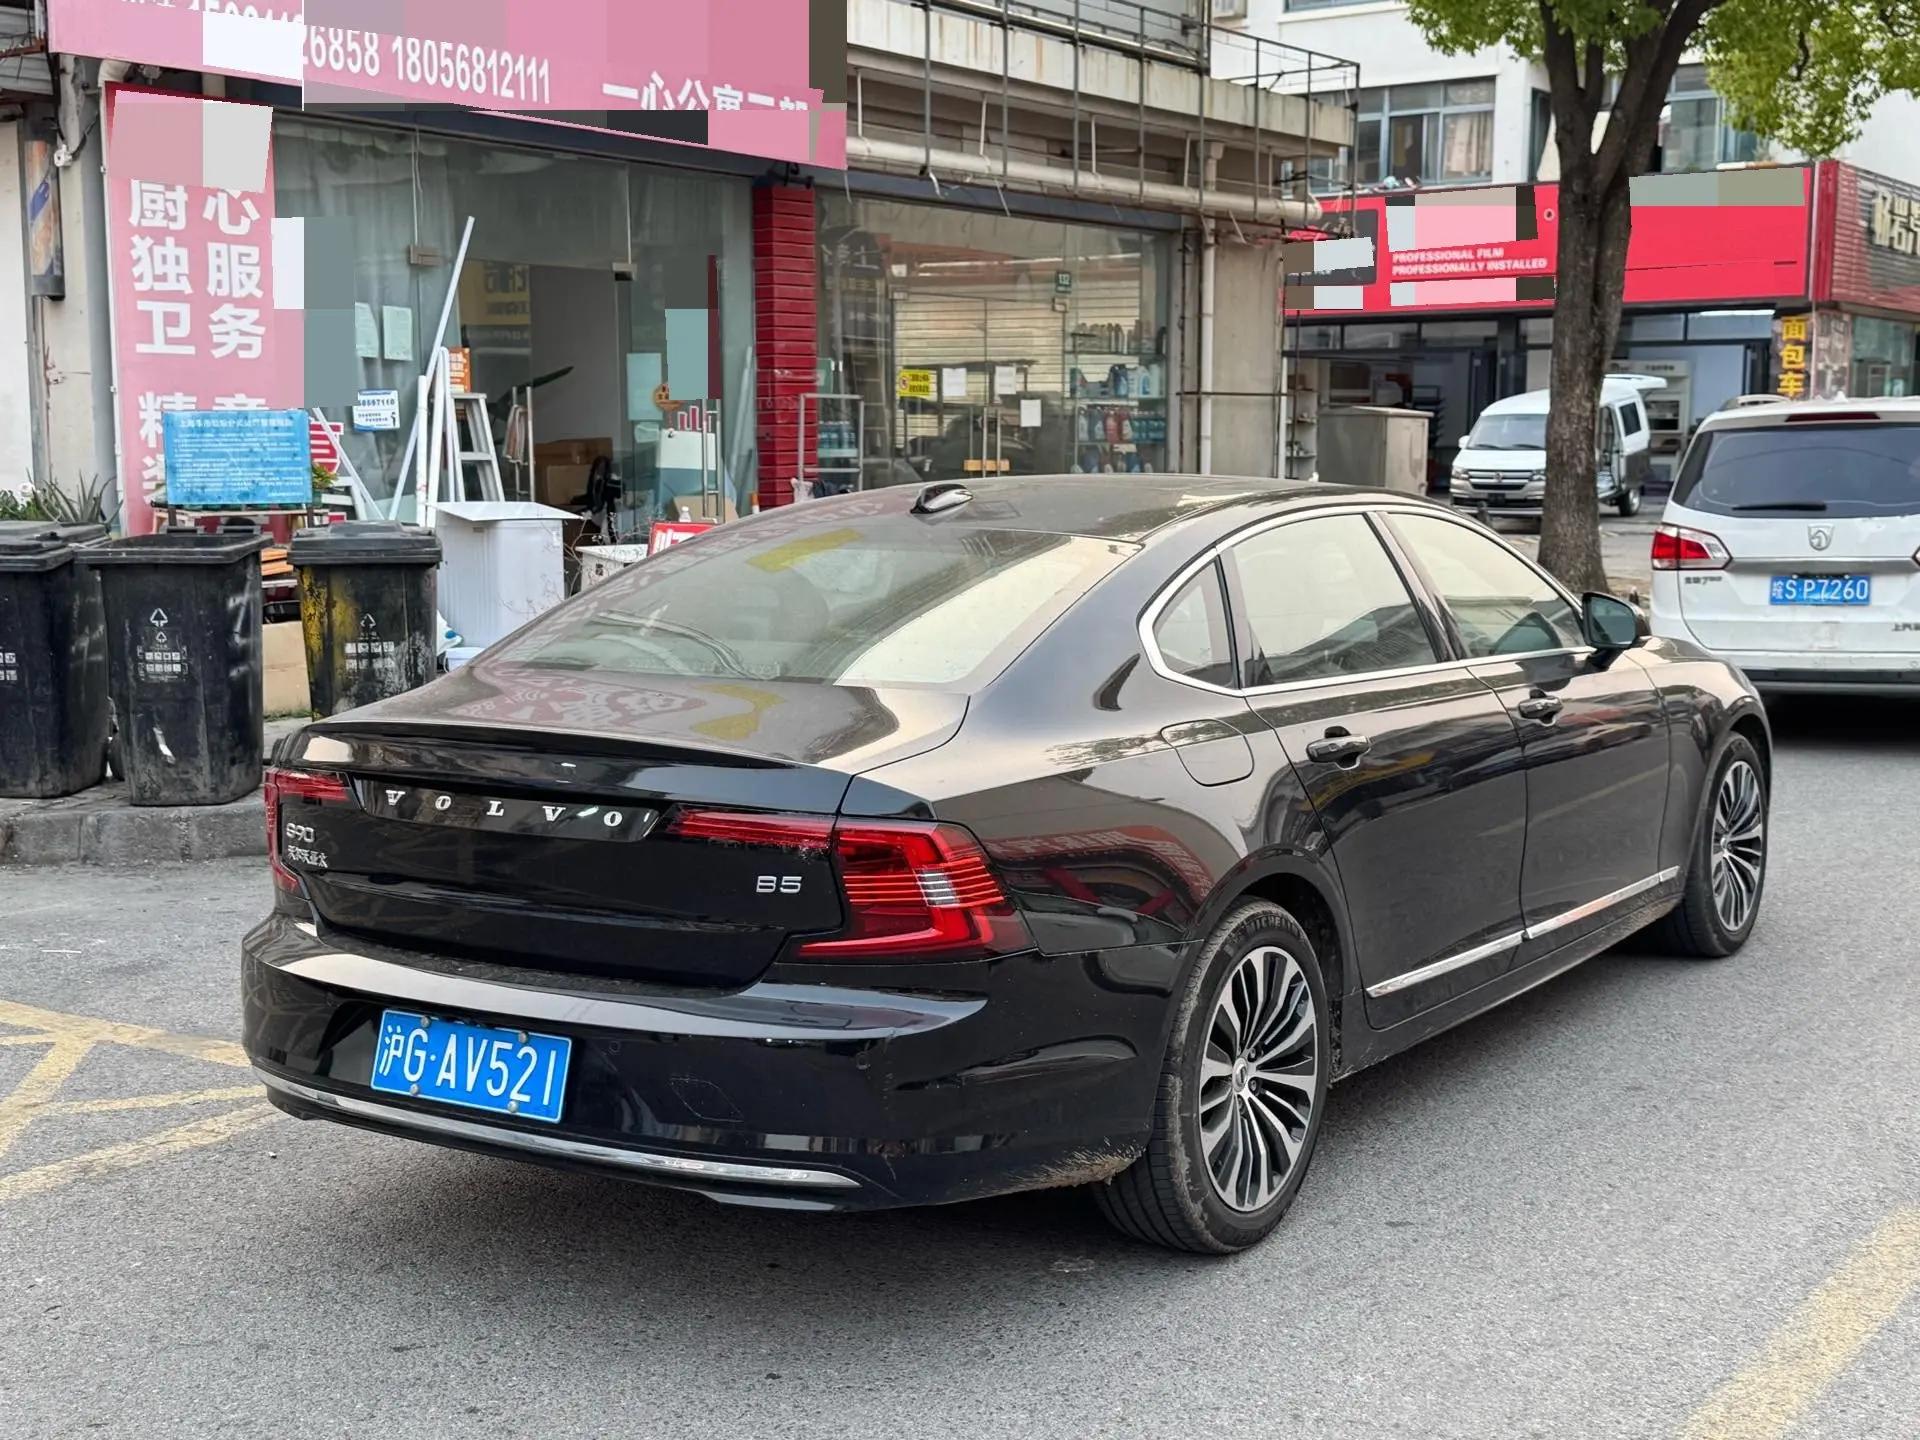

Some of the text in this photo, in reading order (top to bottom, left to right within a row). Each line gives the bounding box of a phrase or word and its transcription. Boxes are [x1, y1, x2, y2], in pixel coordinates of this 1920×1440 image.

[392, 36, 550, 104] 18056812111
[1391, 257, 1548, 276] PROFESSIONALLY INSTALLED
[1392, 247, 1505, 263] PROFESSIONAL FILM
[1776, 316, 1808, 400] 面包车
[385, 789, 624, 828] VOLVO
[286, 822, 315, 843] S90
[756, 875, 803, 894] B5
[378, 1024, 557, 1106] 沪G·AV521
